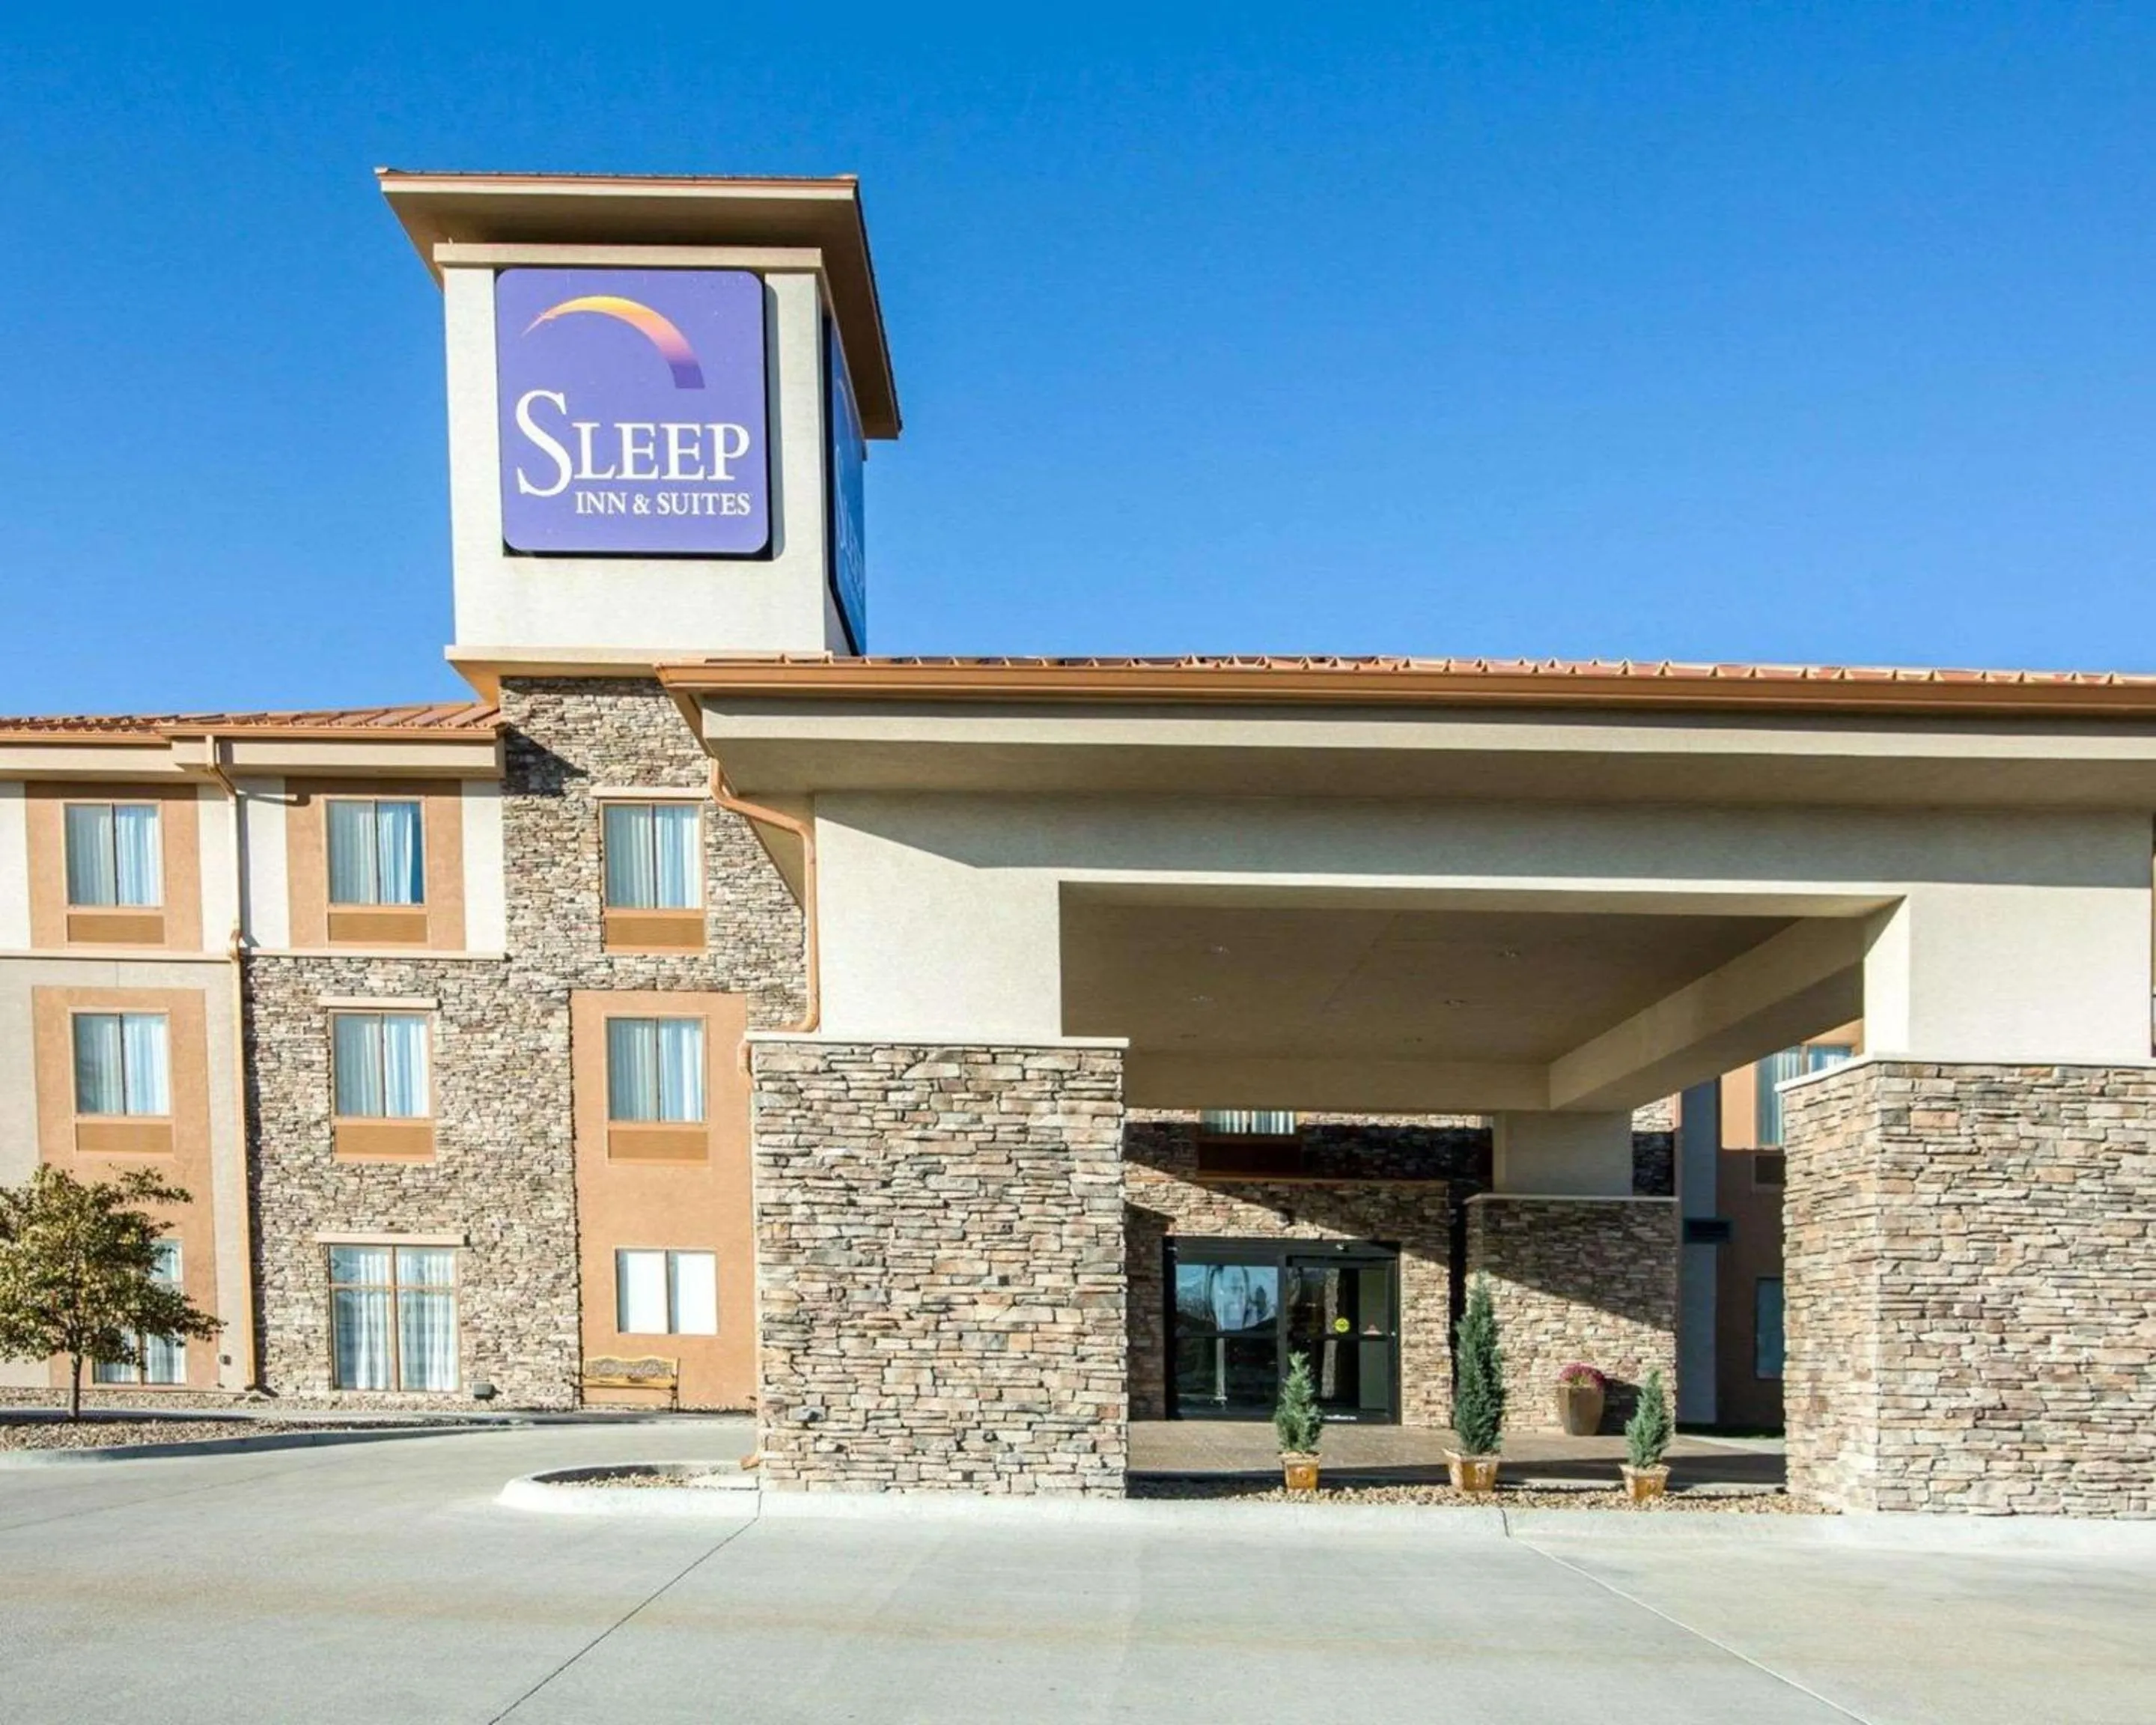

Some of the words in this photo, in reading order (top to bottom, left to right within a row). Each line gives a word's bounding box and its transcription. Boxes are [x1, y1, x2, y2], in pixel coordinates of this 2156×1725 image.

[515, 389, 750, 497] SLEEP
[576, 491, 627, 514] INN
[632, 493, 651, 515] &
[657, 492, 752, 516] SUITES
